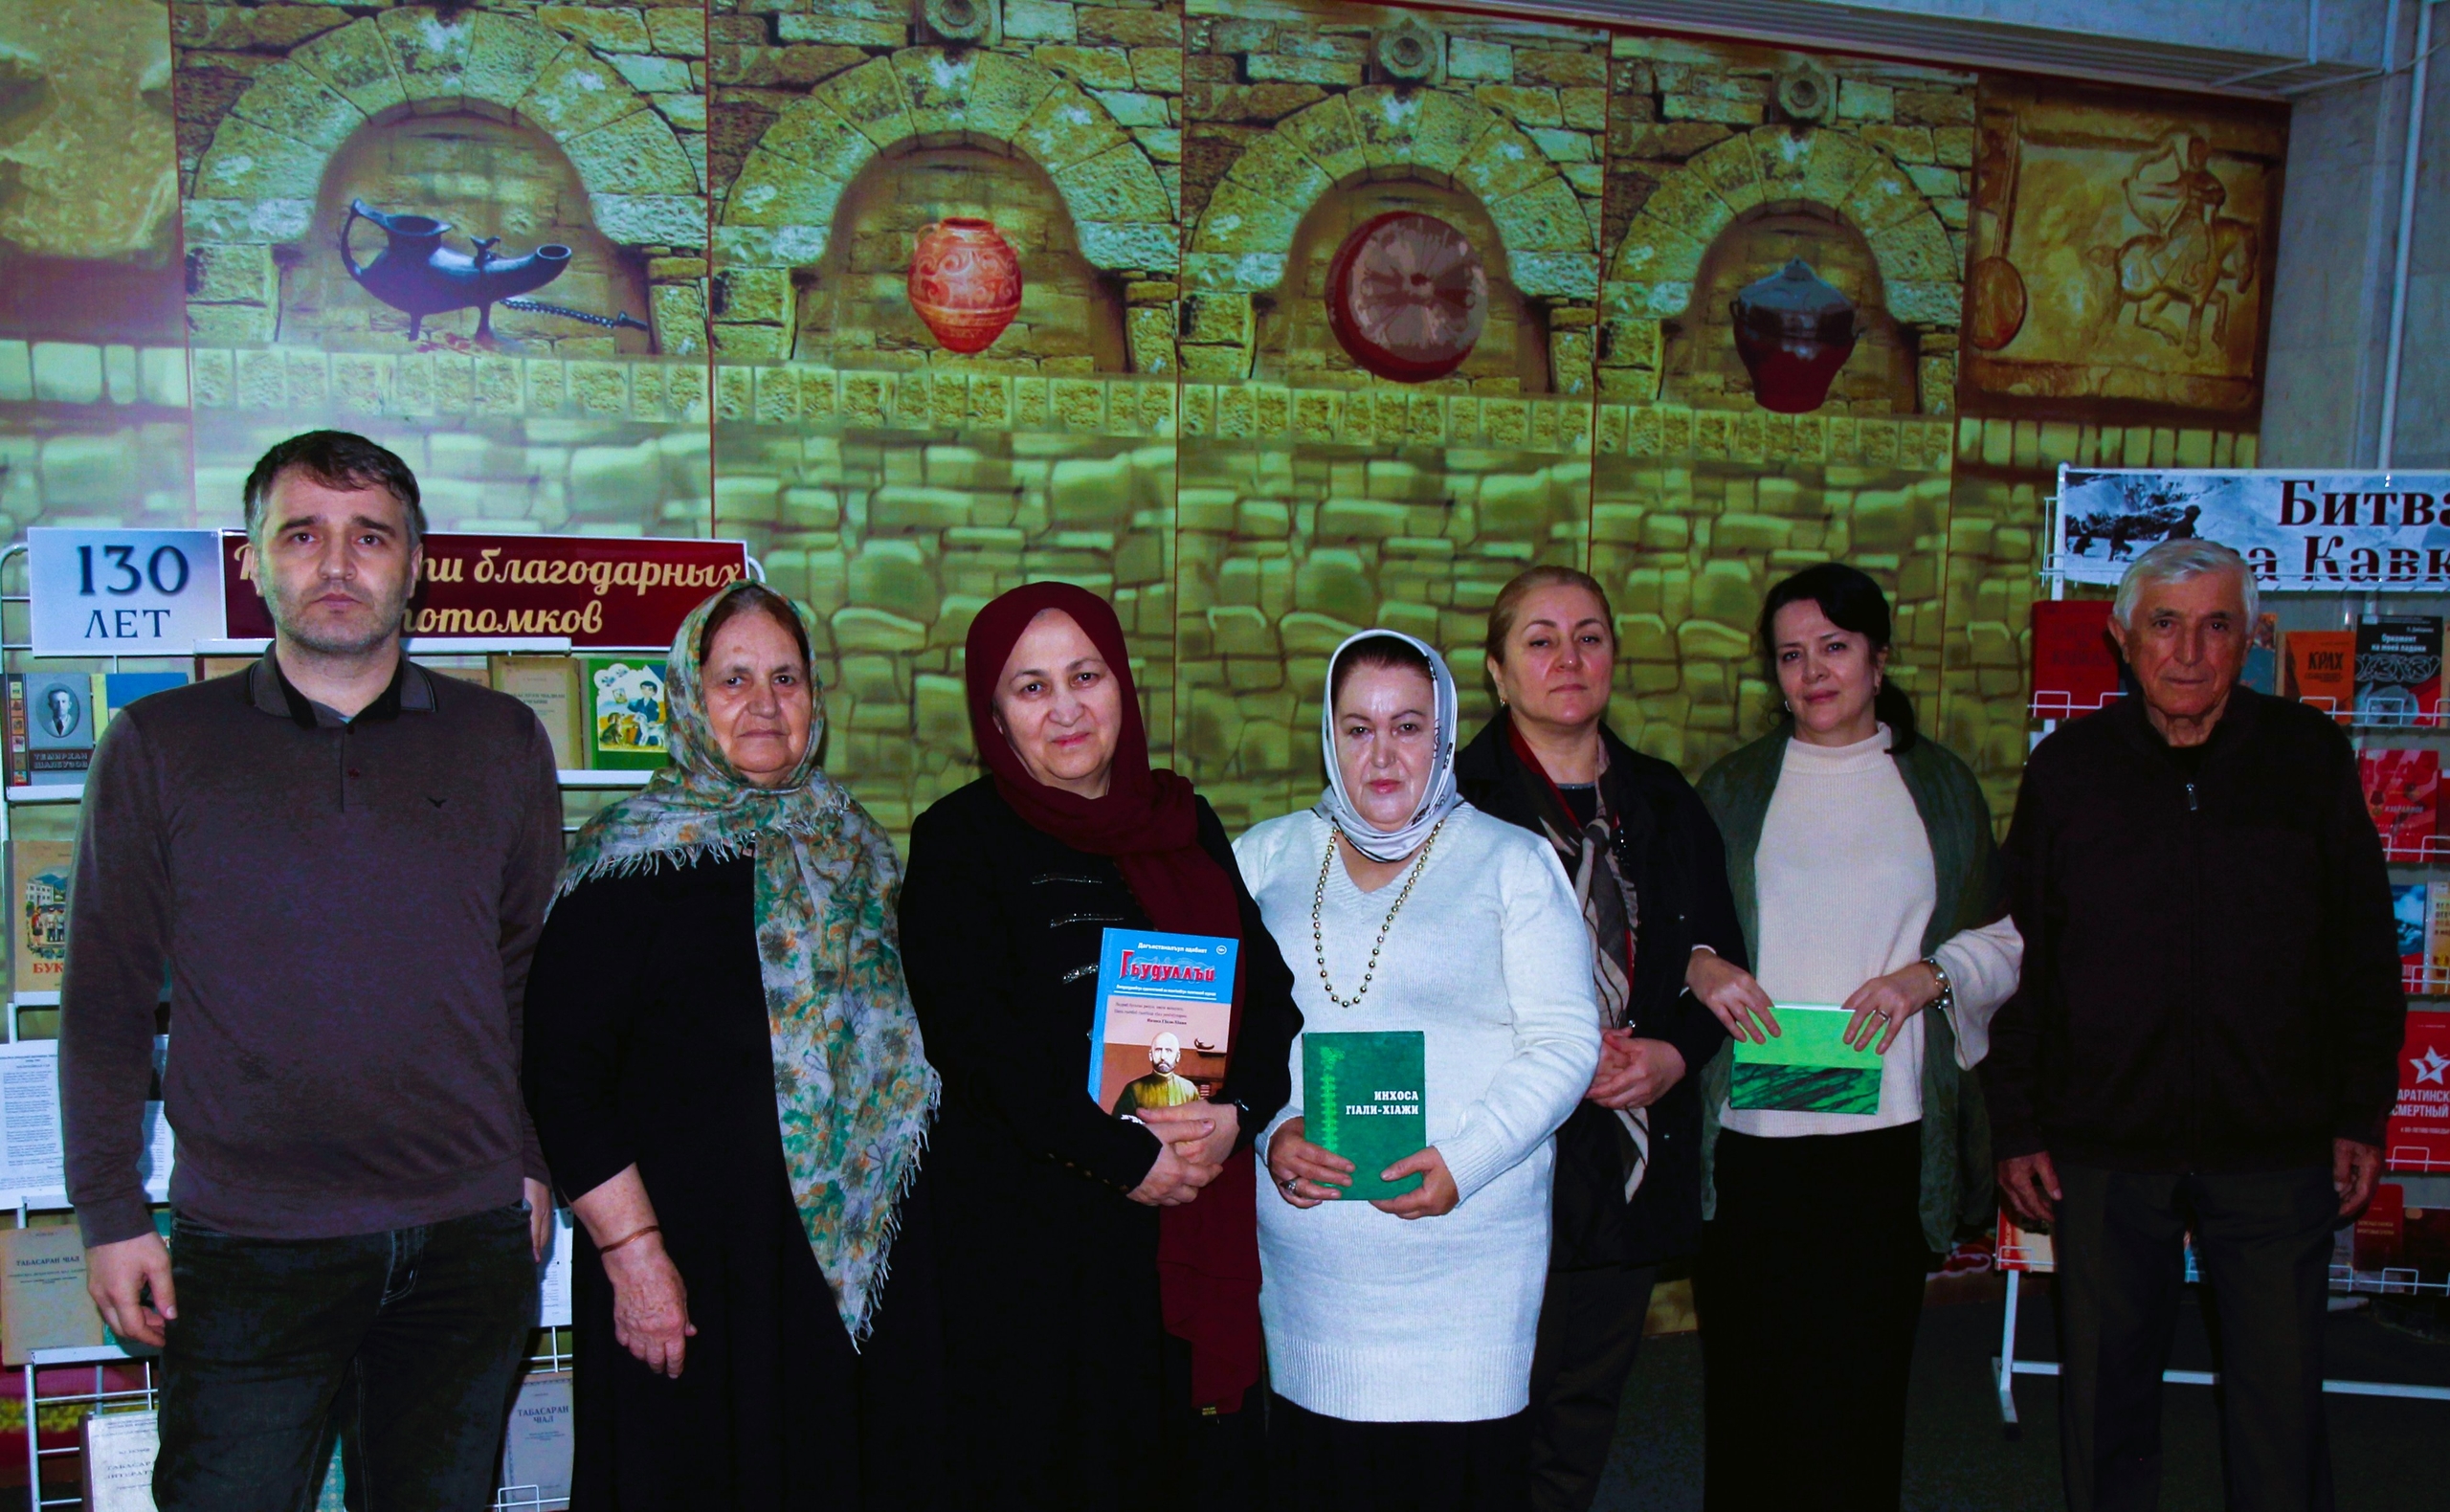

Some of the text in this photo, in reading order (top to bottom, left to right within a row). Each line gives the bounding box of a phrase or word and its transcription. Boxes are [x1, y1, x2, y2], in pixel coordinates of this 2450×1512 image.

[78, 545, 189, 596] 130
[474, 547, 742, 596] благодарных
[2231, 547, 2279, 582] а
[85, 610, 170, 638] ЛЕТ
[2307, 652, 2345, 671] КРАХ
[1374, 1091, 1418, 1101] ИНХОСА
[2396, 1088, 2450, 1102] АРАТИНСК
[2389, 1103, 2448, 1117] СМЕРТНЫЙ
[16, 1256, 60, 1266] ТАБАСАРАН
[517, 1405, 569, 1416] ТАБАСАРАН
